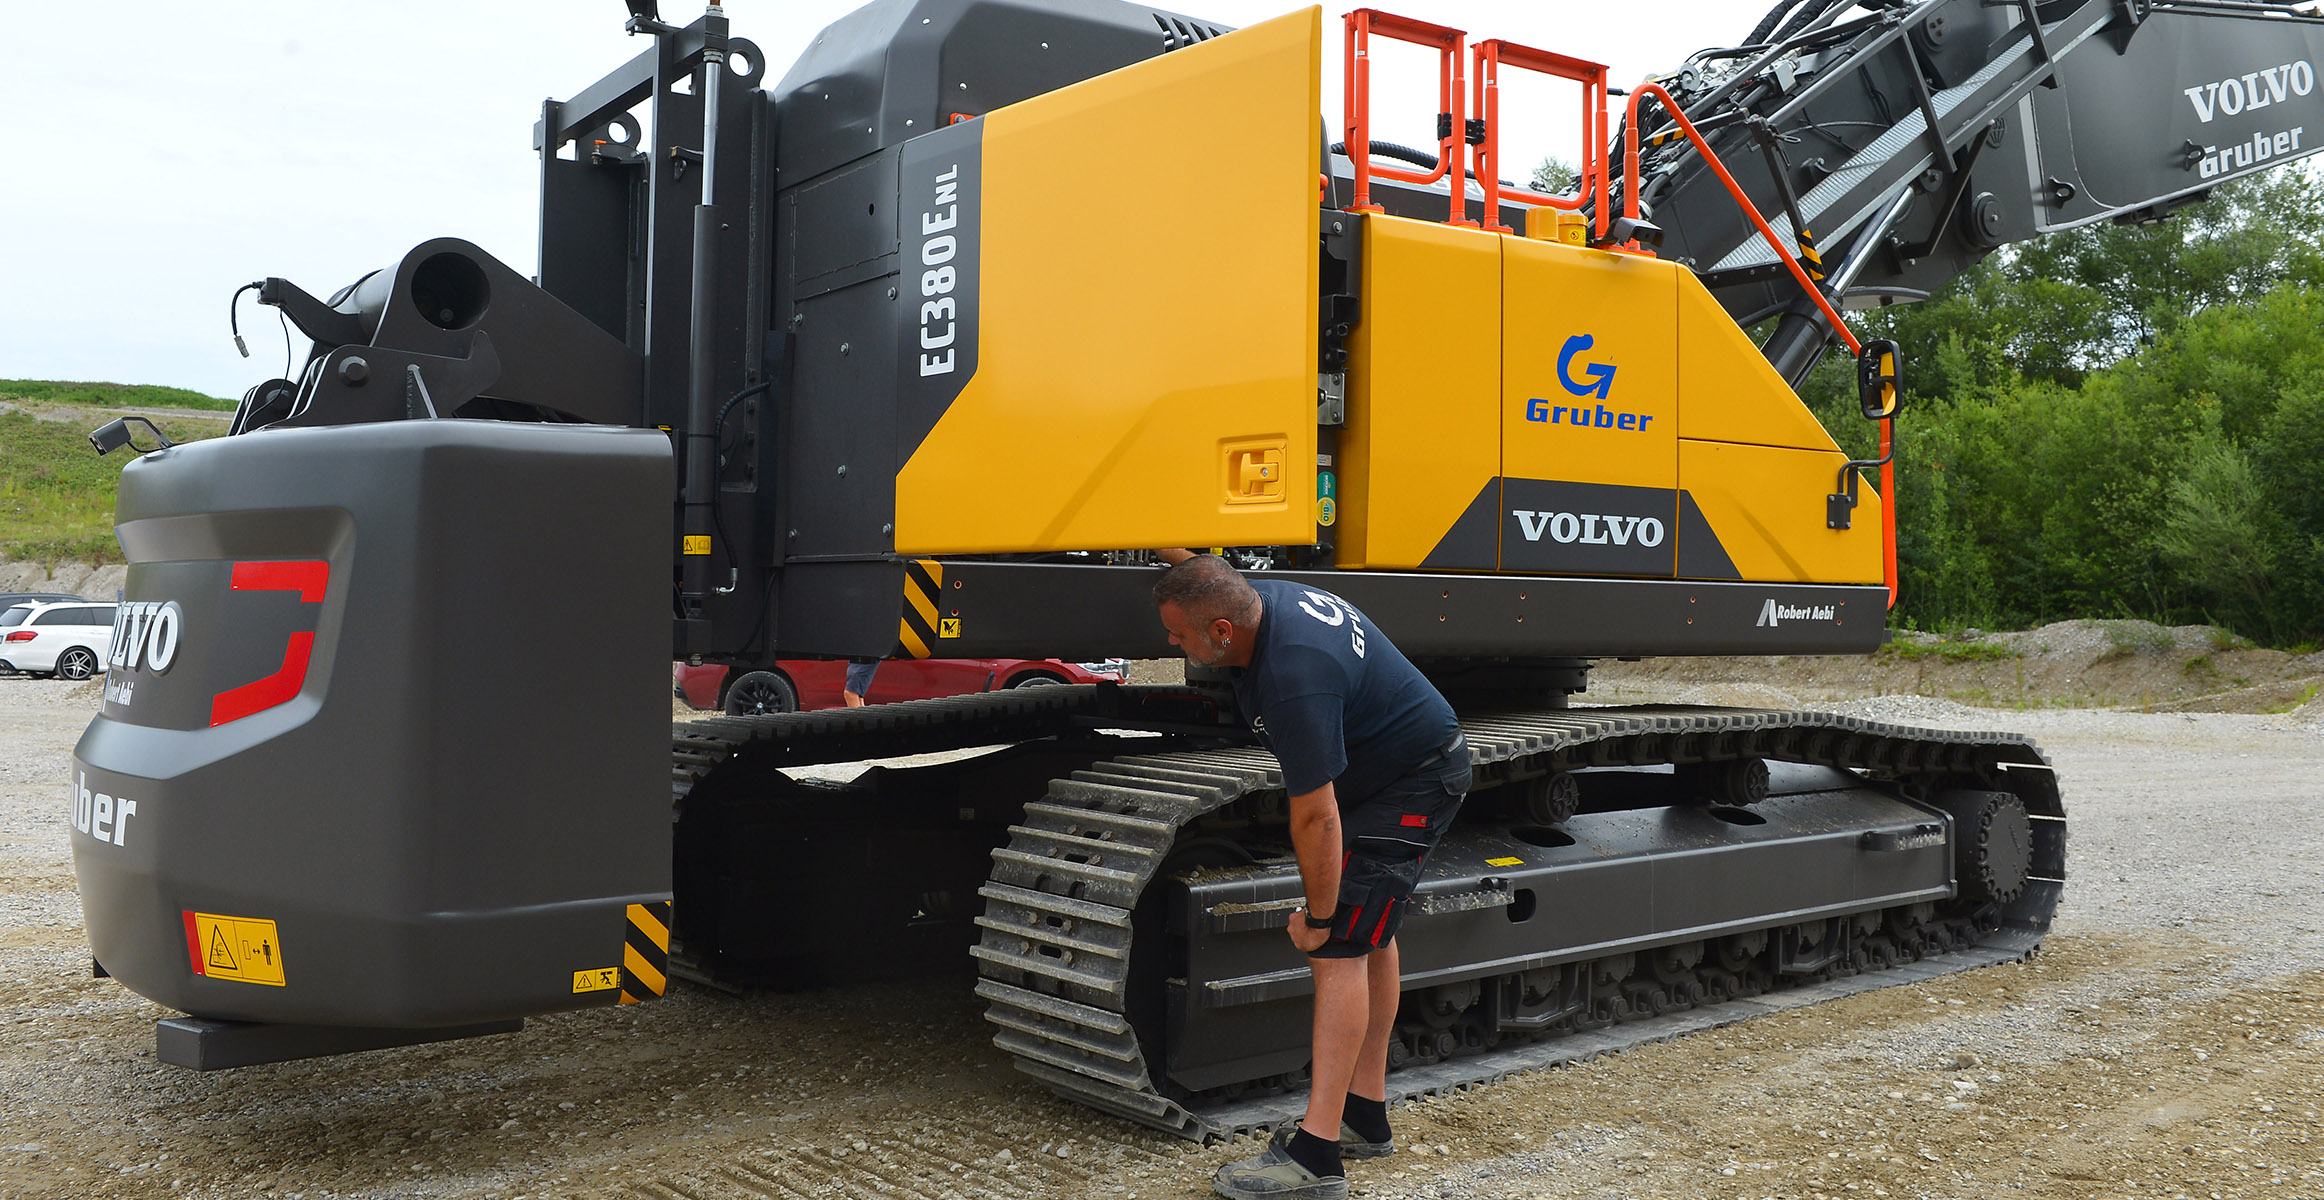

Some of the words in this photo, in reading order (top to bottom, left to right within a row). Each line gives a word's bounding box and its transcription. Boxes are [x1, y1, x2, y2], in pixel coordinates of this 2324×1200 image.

[2184, 60, 2314, 123] VOLVO
[2199, 126, 2303, 179] Gruber
[1526, 397, 1653, 432] Gruber
[1512, 509, 1665, 547] VOLVO
[1777, 604, 1811, 620] Robert
[1811, 605, 1835, 620] Aebi
[71, 770, 137, 847] uber
